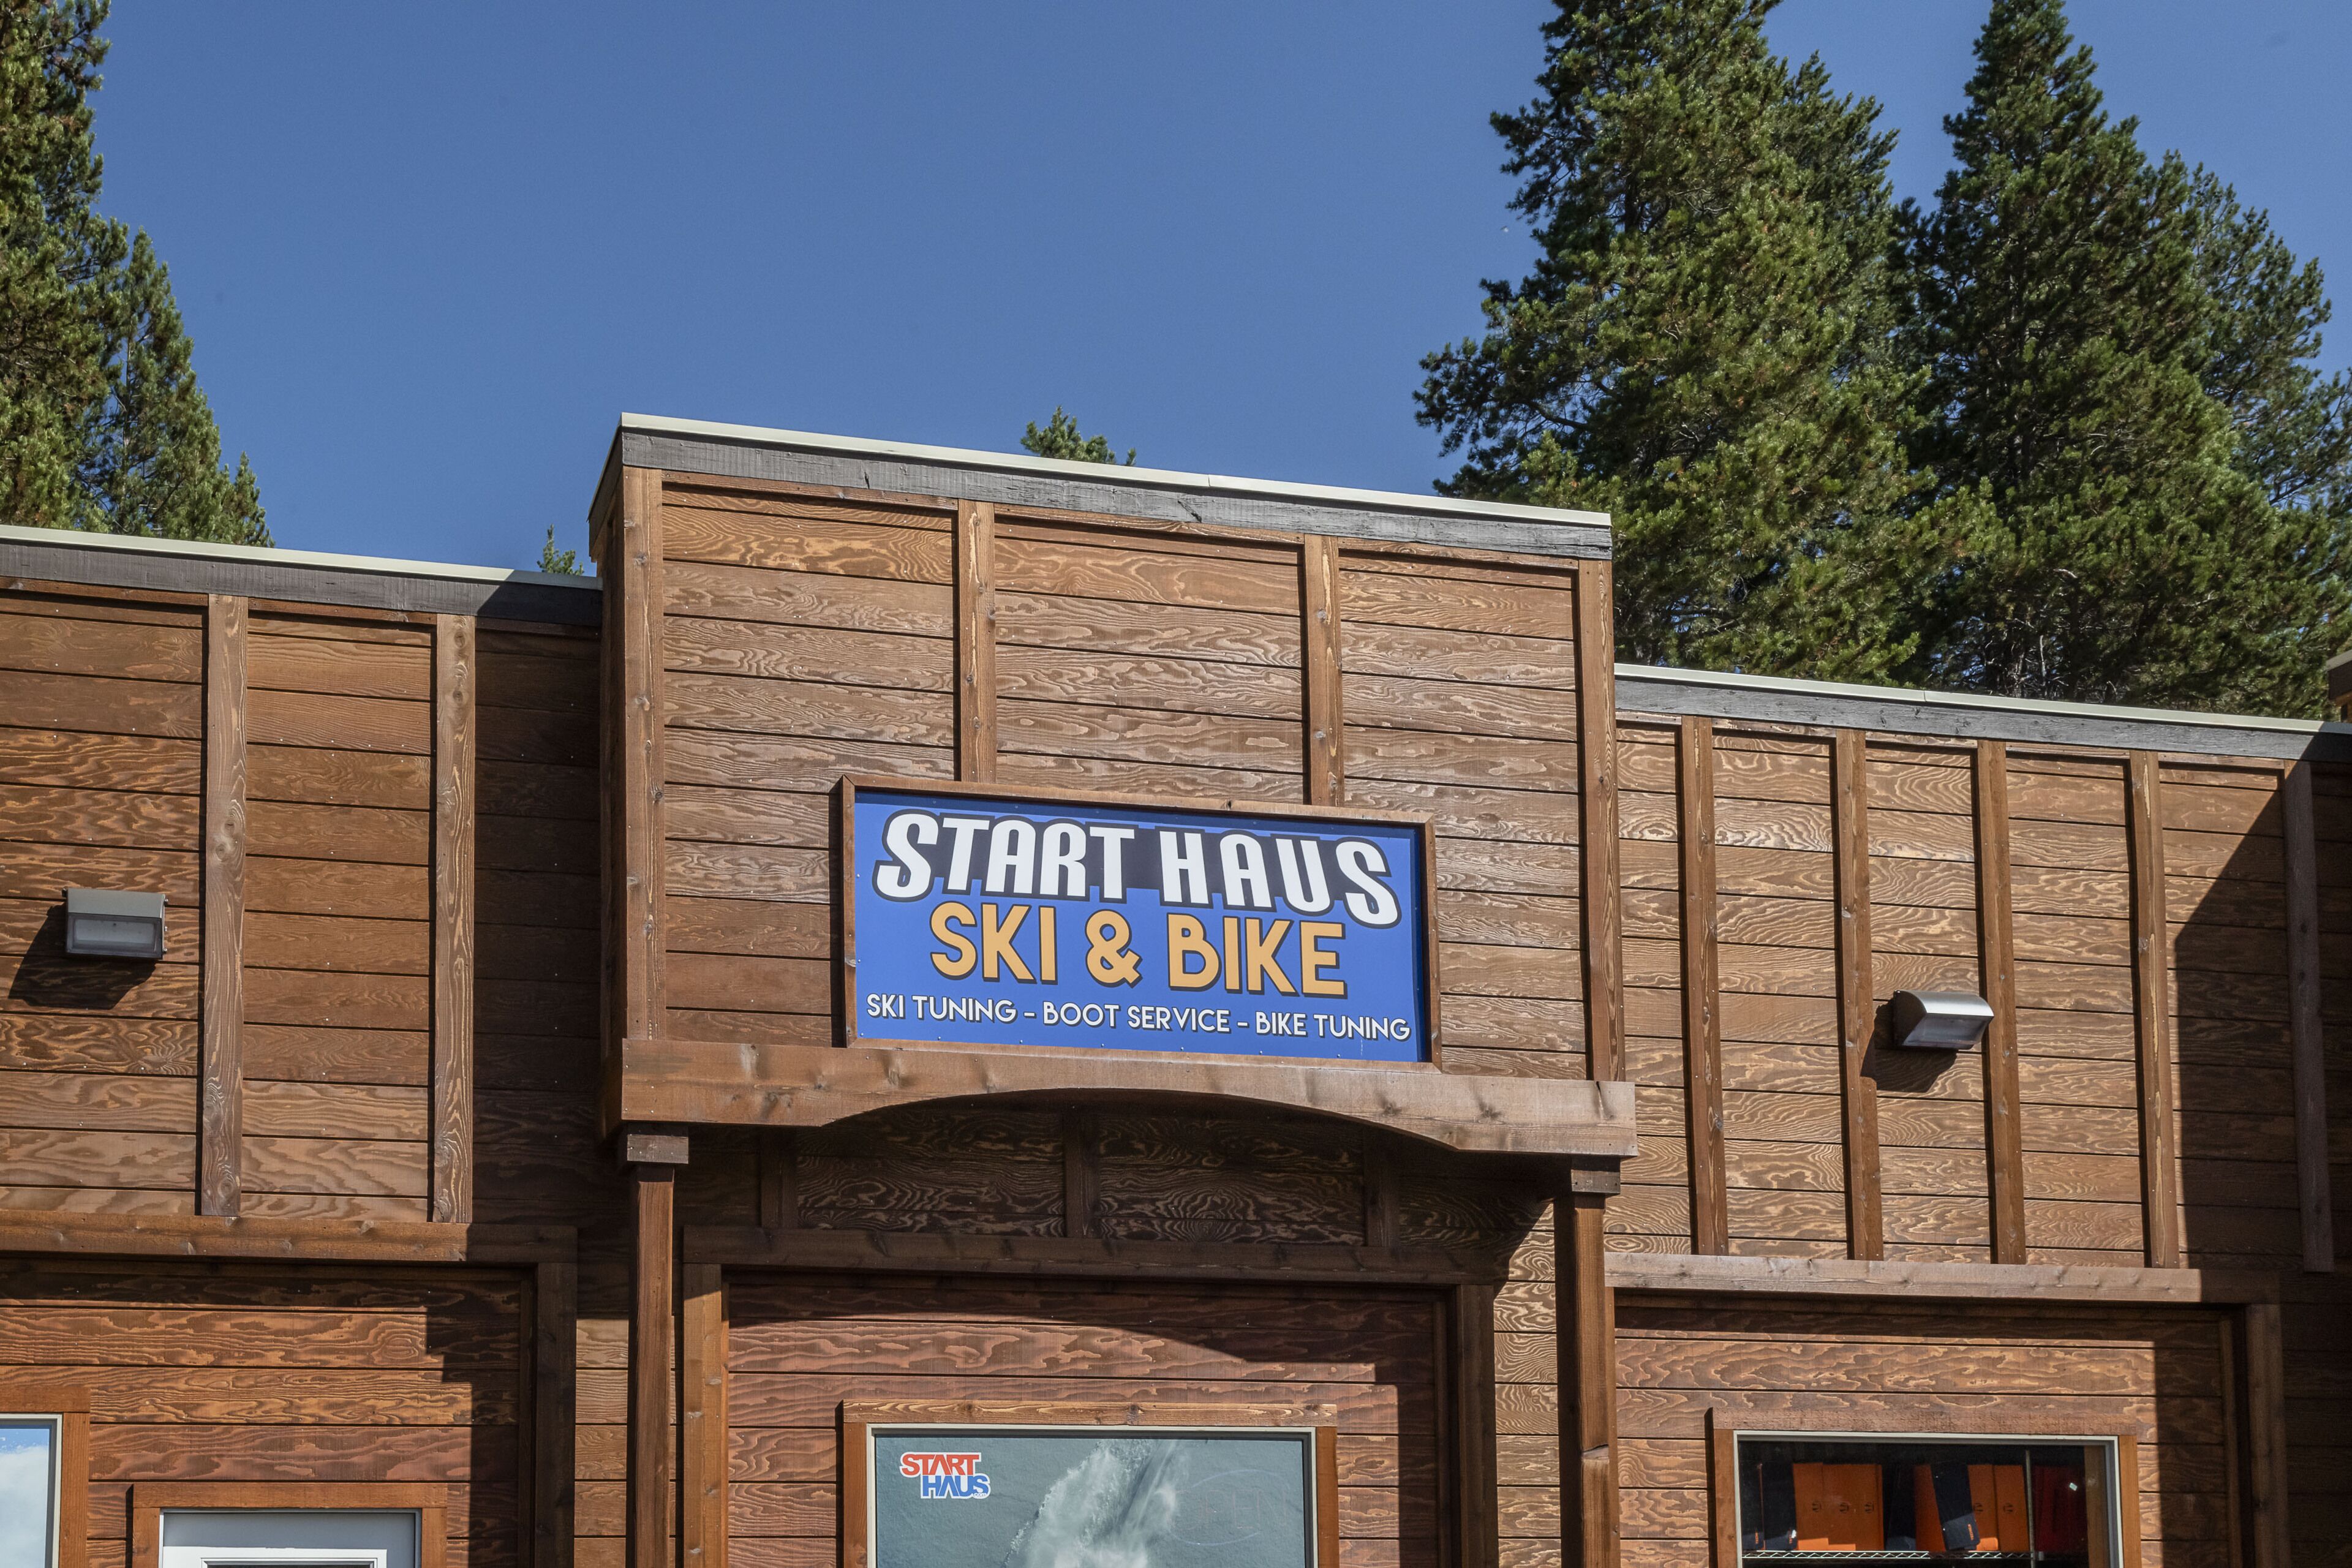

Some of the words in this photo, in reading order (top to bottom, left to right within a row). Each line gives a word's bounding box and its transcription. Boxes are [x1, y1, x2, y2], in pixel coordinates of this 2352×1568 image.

[875, 812, 1136, 900] START
[1158, 829, 1400, 926] HAUS
[930, 901, 1057, 984] SKI
[1085, 910, 1142, 987] &
[1167, 913, 1347, 999] BIKE
[867, 993, 905, 1019] SKI
[912, 995, 1017, 1023] TUNING
[1043, 1001, 1121, 1028] BOOT
[1127, 1005, 1231, 1033] SERVICE
[1256, 1011, 1307, 1036] BIKE
[1314, 1014, 1411, 1040] TUNING
[902, 1453, 980, 1476] START
[922, 1475, 989, 1496] HAUS
